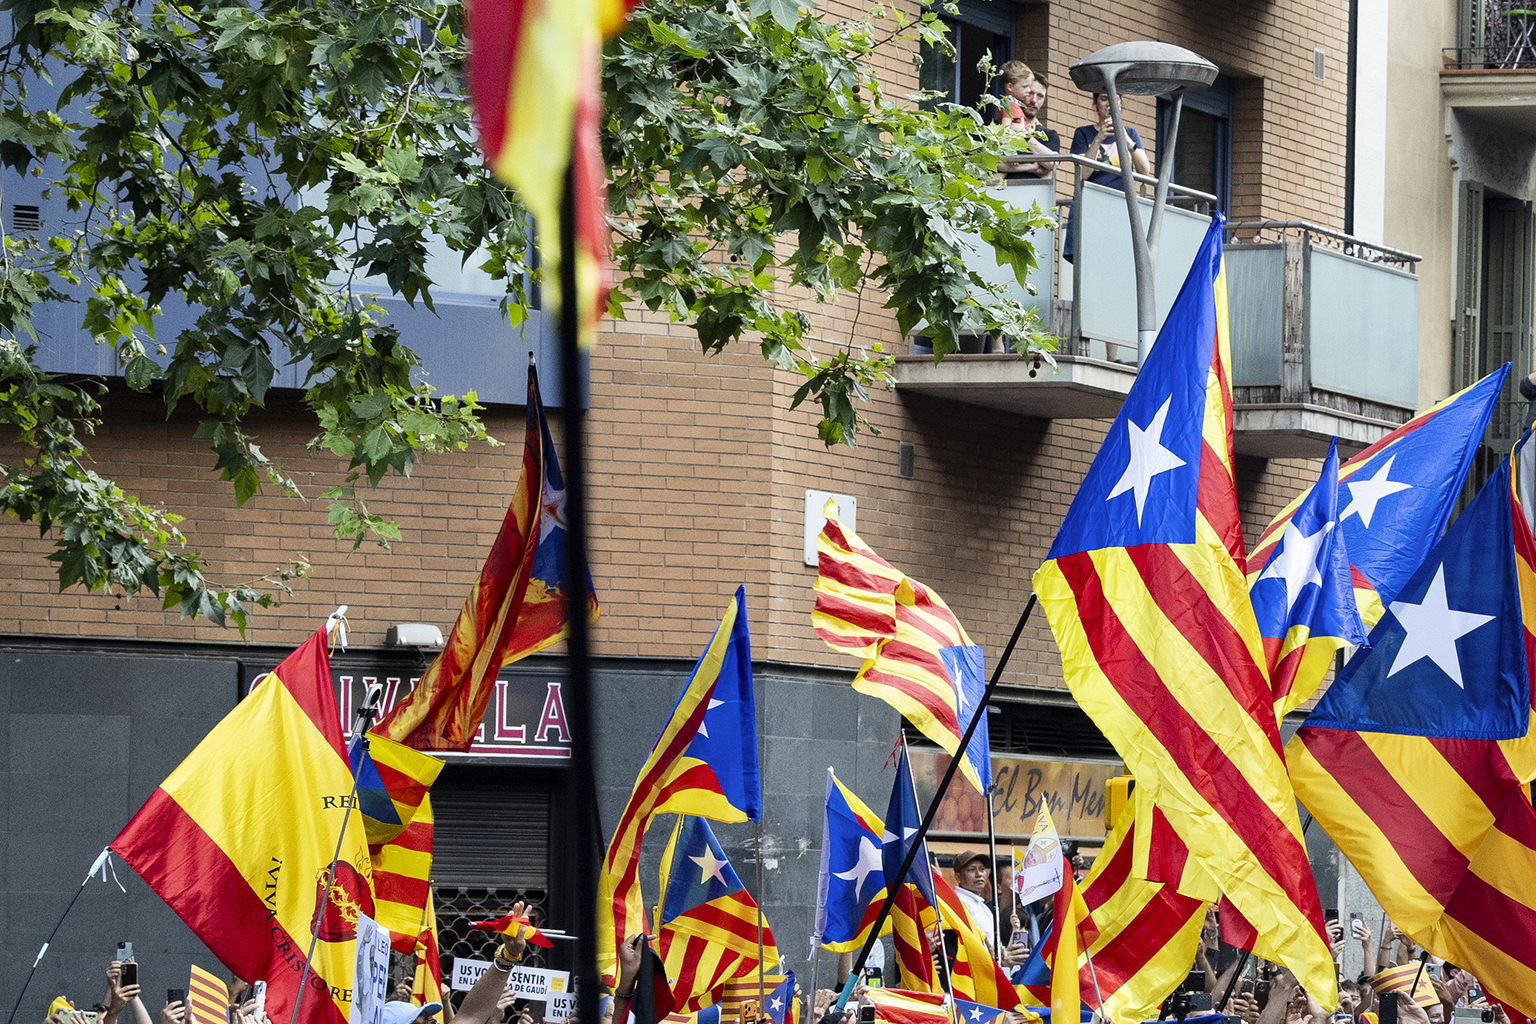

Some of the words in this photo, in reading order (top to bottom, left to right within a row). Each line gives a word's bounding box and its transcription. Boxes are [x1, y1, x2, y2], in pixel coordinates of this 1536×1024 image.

[992, 764, 1019, 818] El
[1068, 772, 1106, 821] Men
[460, 964, 472, 976] US
[511, 971, 546, 986] SENTIR
[329, 985, 354, 1003] RE
[458, 976, 469, 985] EN
[514, 985, 525, 993] DE
[525, 986, 548, 995] GAUDÍ
[553, 997, 567, 1009] US
[569, 999, 576, 1010] V
[552, 1009, 563, 1018] EN
